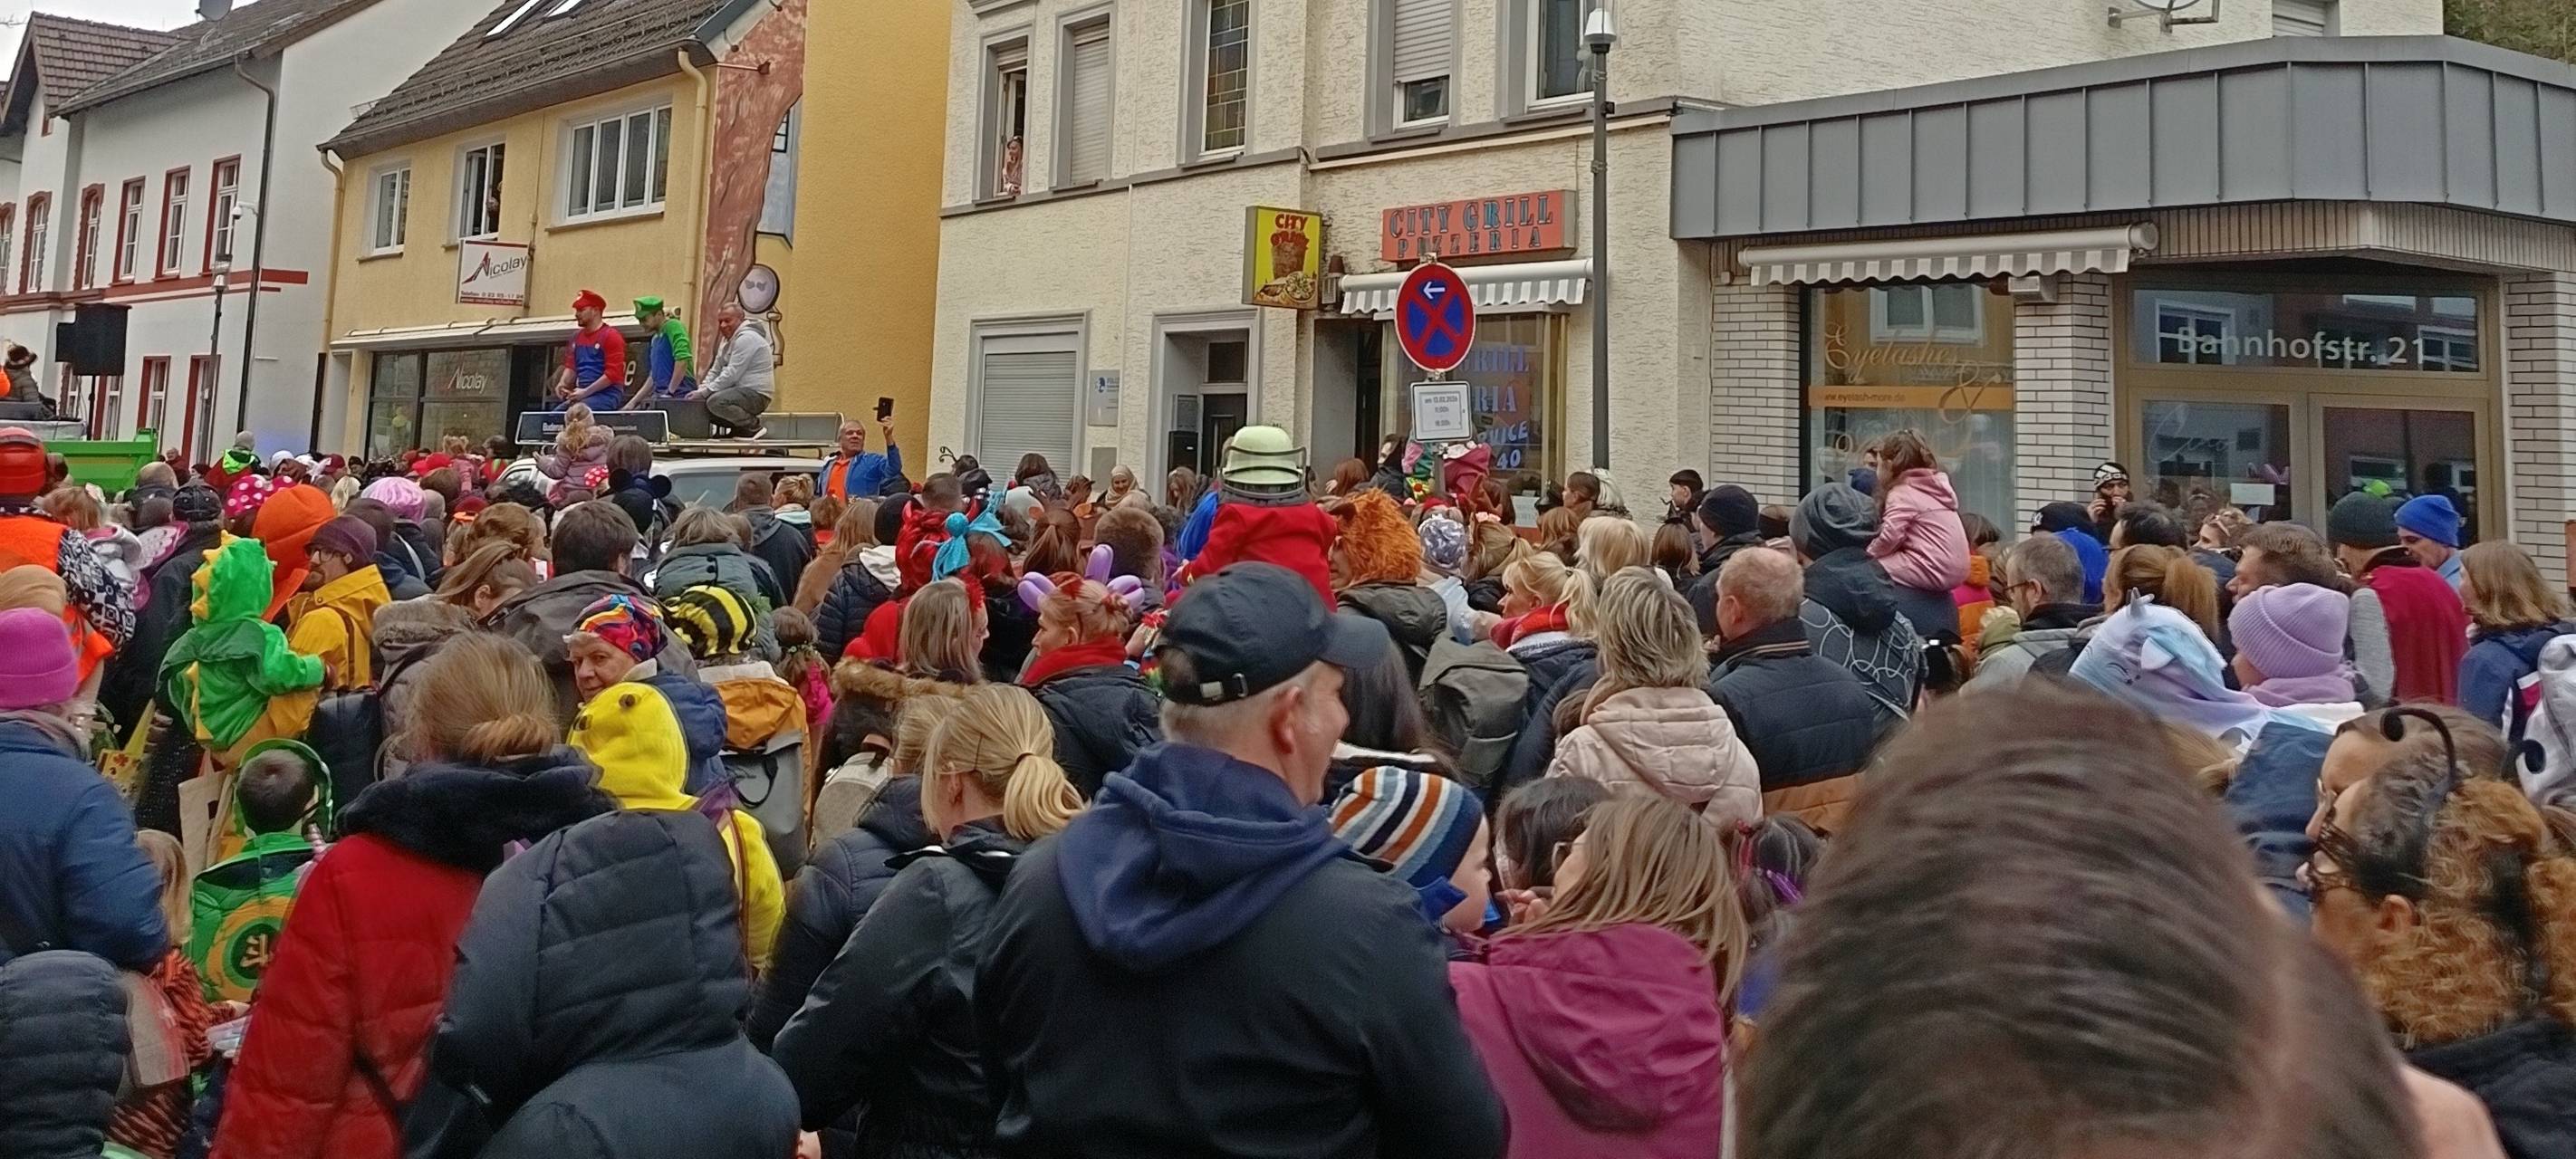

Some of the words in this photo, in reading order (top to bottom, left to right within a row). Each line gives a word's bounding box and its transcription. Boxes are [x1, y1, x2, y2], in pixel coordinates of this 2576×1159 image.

[1274, 213, 1308, 232] CITY
[1389, 205, 1451, 238] CITY
[1463, 195, 1553, 232] GRILL
[1398, 226, 1542, 259] PIZZERIA
[461, 251, 528, 285] Nicolay
[1824, 321, 1958, 384] Eyelashes
[2177, 326, 2378, 363] Bahnhofstr.
[2387, 336, 2424, 365] 21
[447, 362, 490, 395] Nicolay
[1823, 389, 1907, 404] ww.eyelash-more.de
